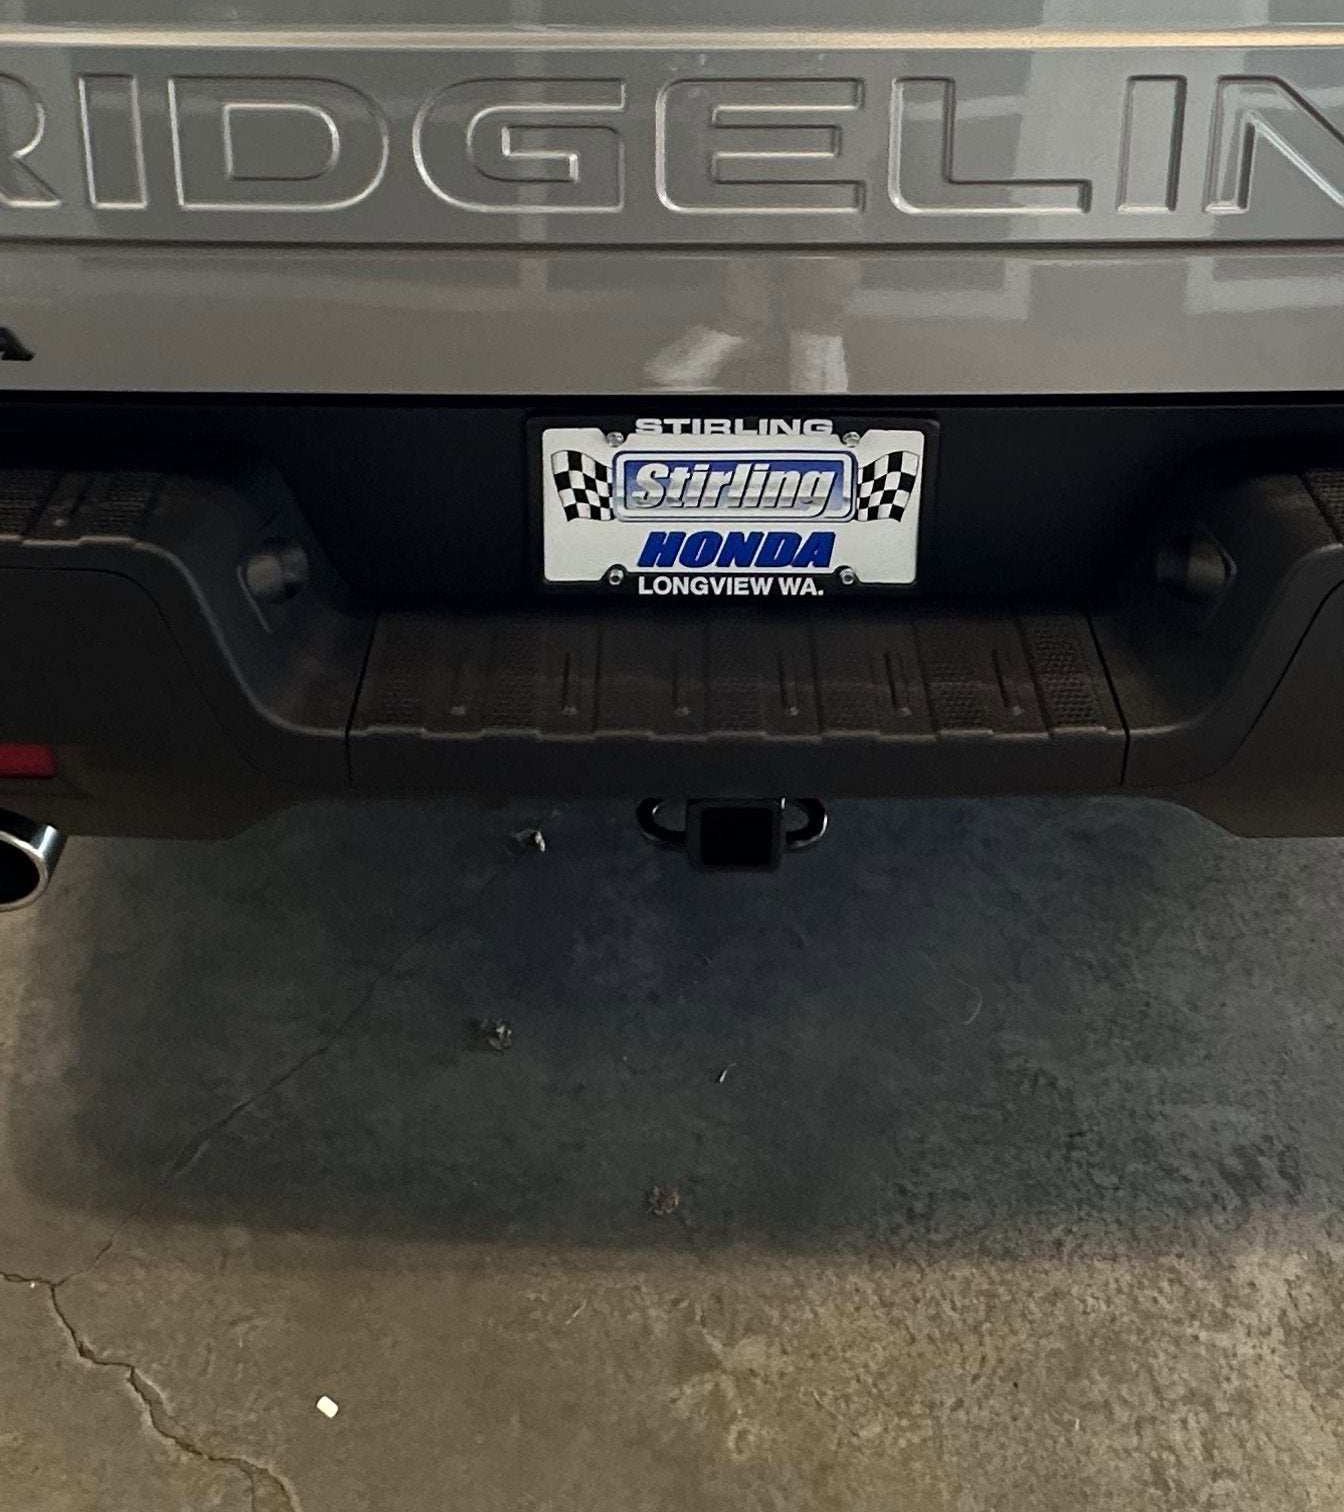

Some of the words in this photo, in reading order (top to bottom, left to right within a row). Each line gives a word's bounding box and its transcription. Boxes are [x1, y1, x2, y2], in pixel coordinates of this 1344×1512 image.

[635, 417, 833, 436] STIRLING
[631, 460, 837, 518] Stirling
[636, 530, 837, 569] HONDA
[638, 575, 778, 596] LONGVIEW
[778, 575, 824, 596] WA.
